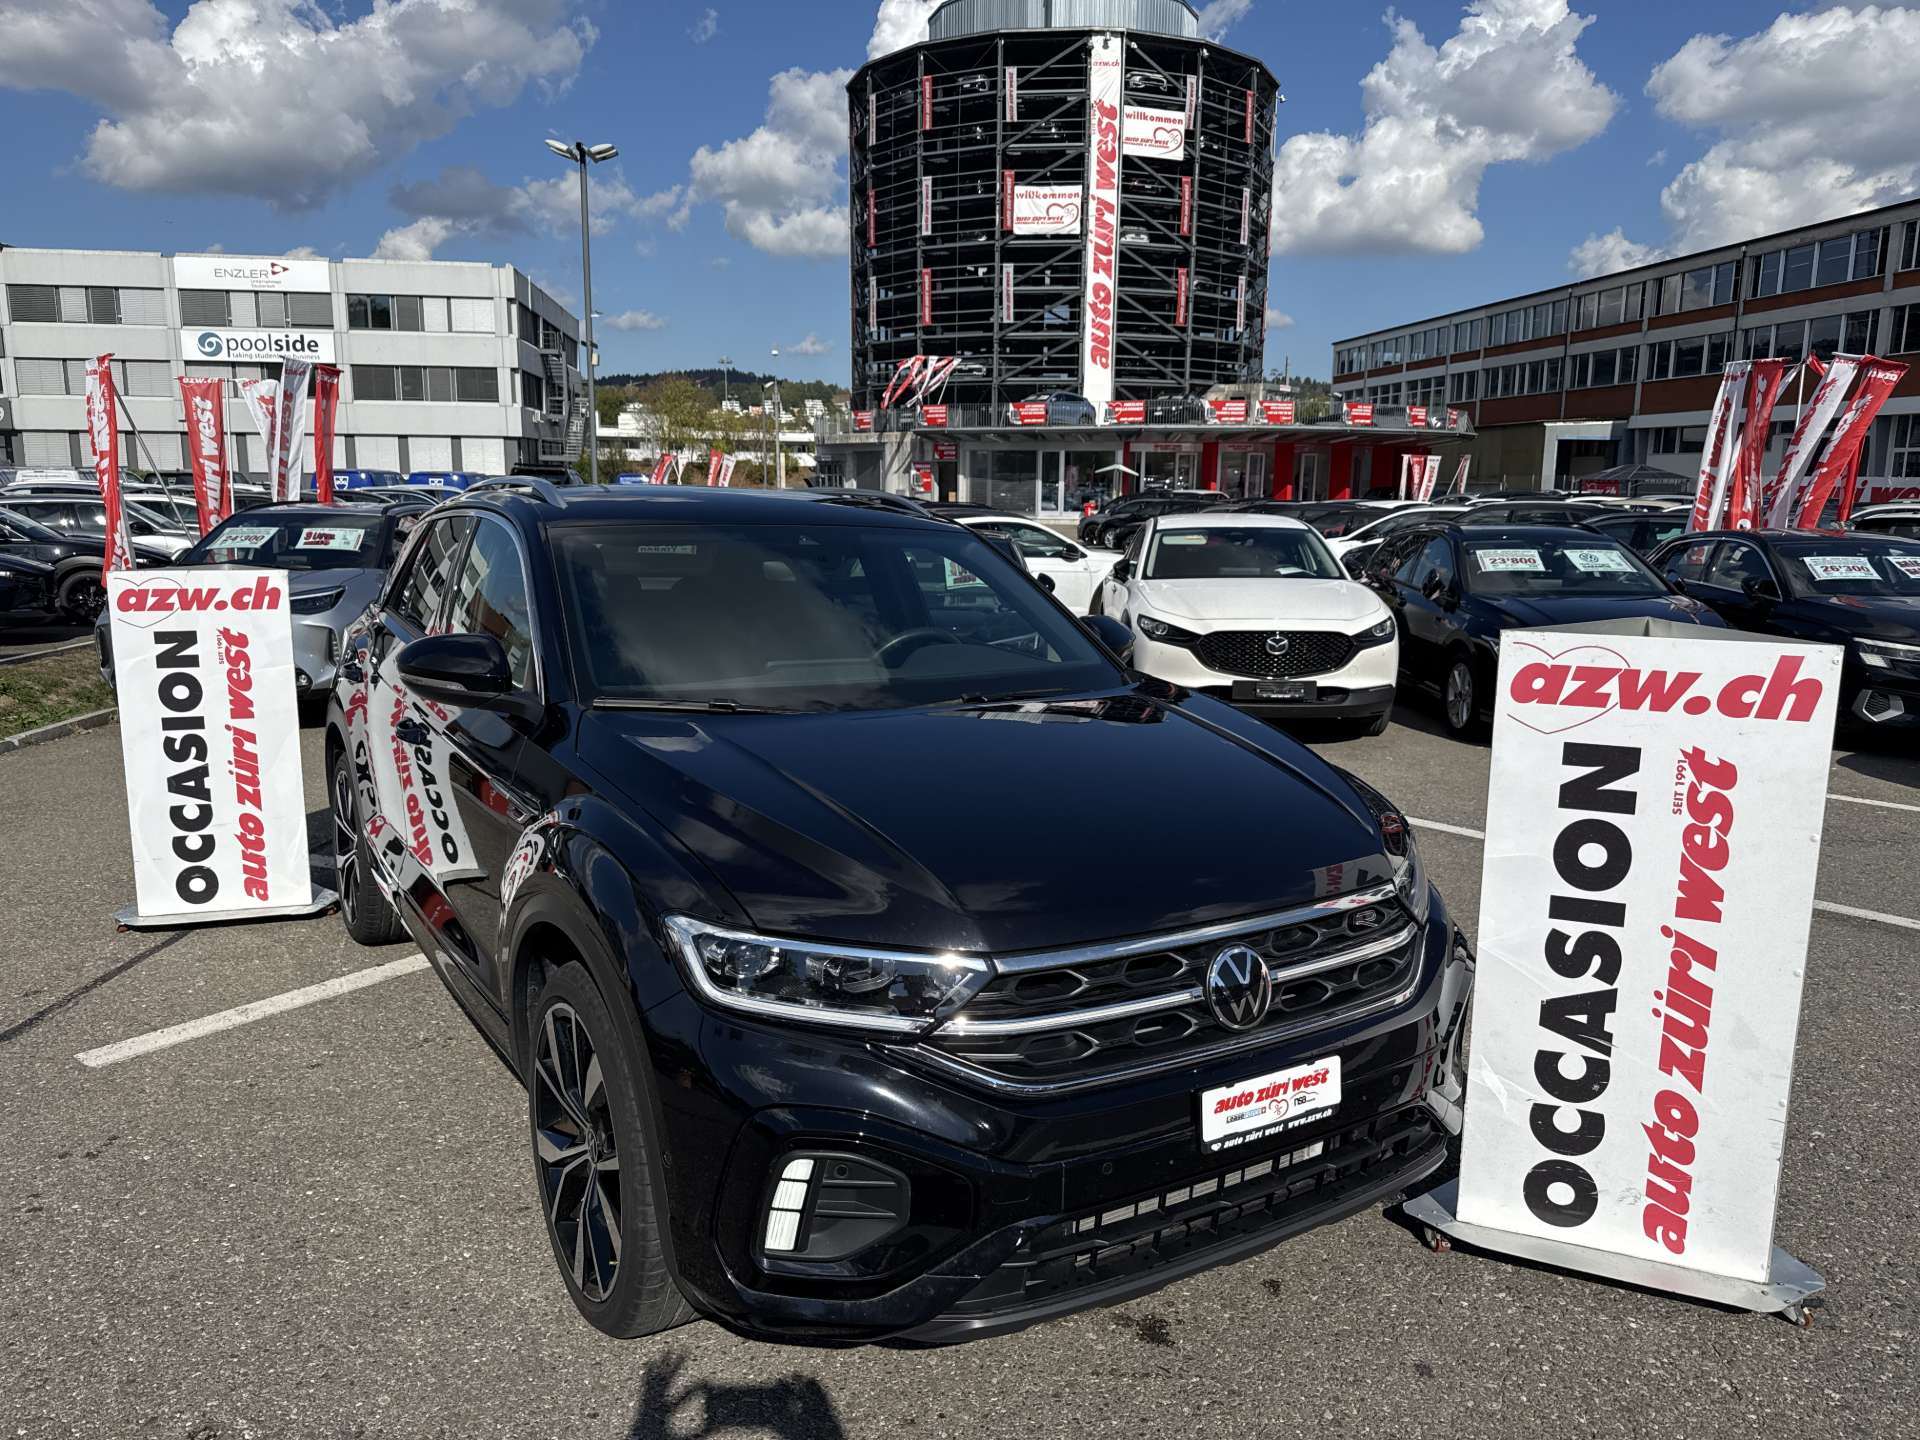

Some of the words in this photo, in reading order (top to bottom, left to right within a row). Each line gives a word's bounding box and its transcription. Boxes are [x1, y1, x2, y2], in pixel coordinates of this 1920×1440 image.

[1093, 99, 1118, 190] west
[1125, 111, 1183, 124] willkommen
[1015, 190, 1080, 199] willkommen
[1088, 194, 1115, 280] züri
[214, 268, 269, 278] ENZLER
[226, 333, 319, 358] poolside
[232, 352, 253, 360] taking
[1088, 282, 1112, 369] auto
[192, 393, 219, 456] west
[1489, 557, 1537, 565] 23'800
[117, 576, 281, 612] azw.ch
[216, 626, 254, 720] west
[1510, 655, 1823, 722] azw.ch
[153, 630, 219, 905] OCCASION
[224, 724, 263, 812] züri
[1675, 759, 1687, 786] 1991
[1671, 787, 1683, 816] SEIT
[234, 811, 269, 902] auto
[1674, 745, 1738, 924] west
[1522, 742, 1642, 1228] OCCASION
[1651, 924, 1719, 1095] züri
[1214, 1088, 1254, 1114] auto
[1254, 1077, 1292, 1103] züri
[1292, 1068, 1330, 1092] west
[1223, 1136, 1244, 1149] auto
[1244, 1129, 1264, 1144] züri
[1264, 1124, 1284, 1137] west
[1642, 1088, 1700, 1256] auto
